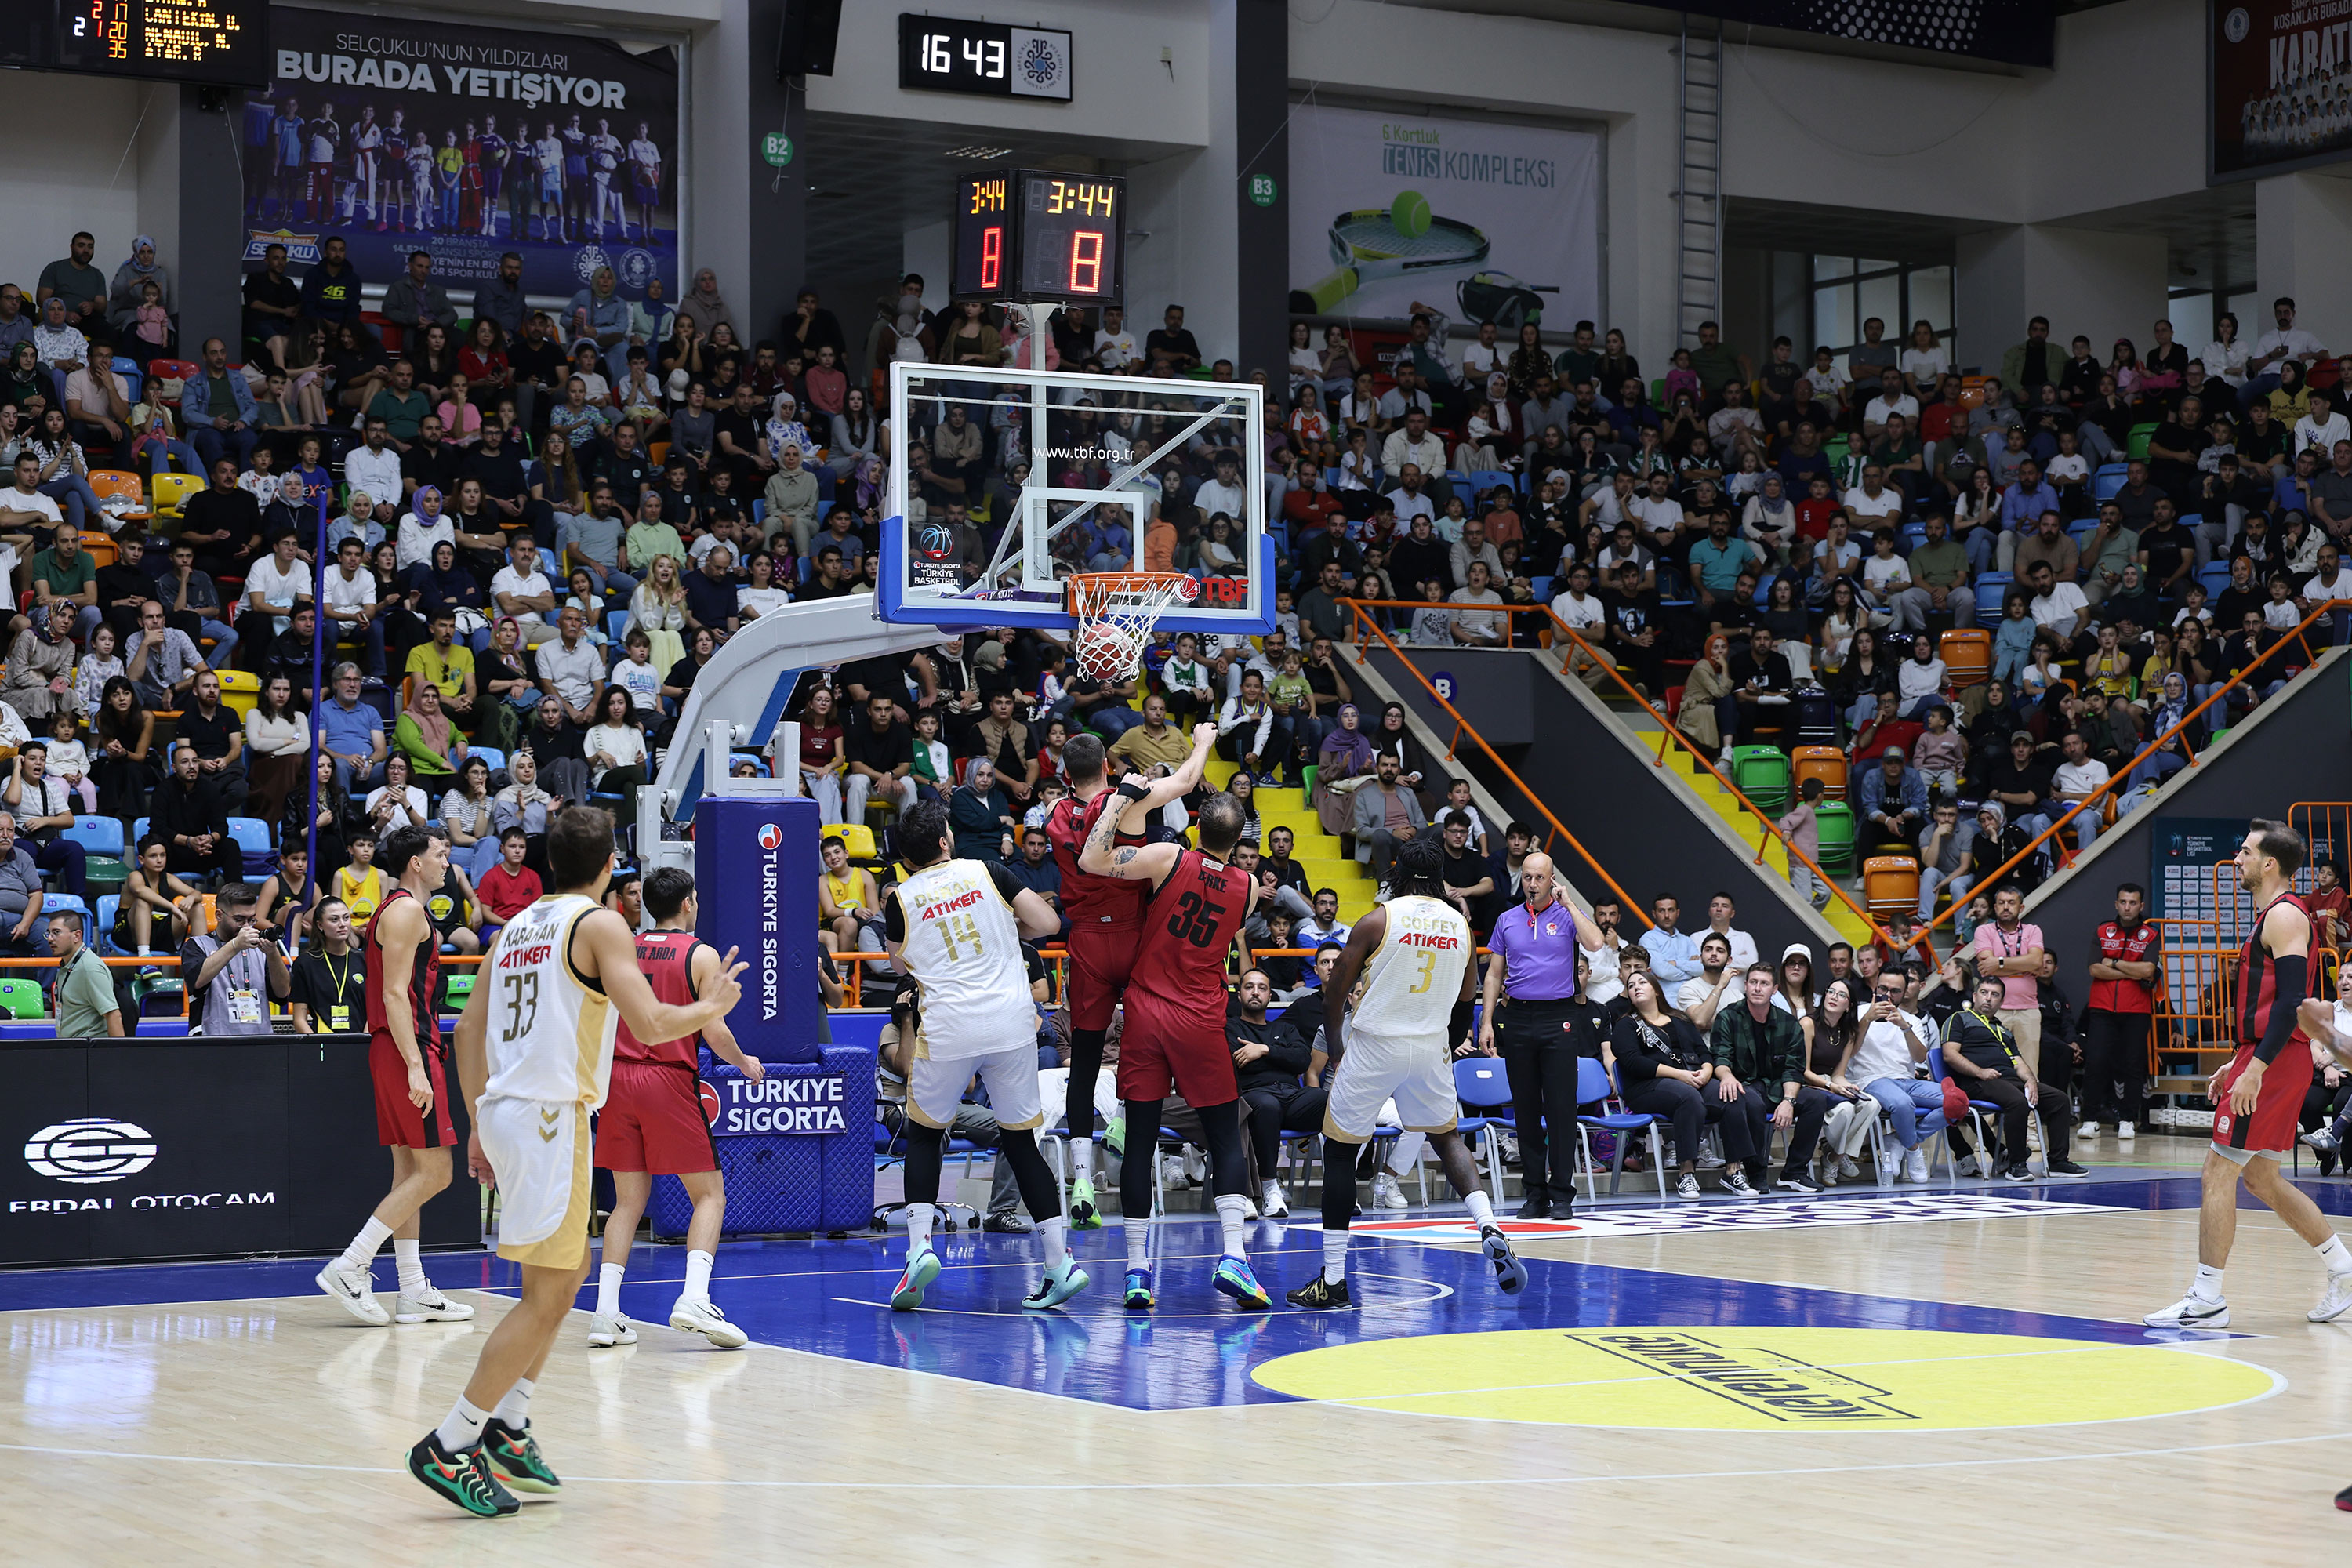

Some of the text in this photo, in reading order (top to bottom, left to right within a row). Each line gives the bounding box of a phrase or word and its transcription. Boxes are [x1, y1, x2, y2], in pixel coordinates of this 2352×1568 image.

[74, 16, 85, 37] 2
[108, 21, 128, 39] 20
[2274, 7, 2318, 31] KOŞANLAR
[108, 40, 127, 59] 35
[336, 33, 568, 71] SELÇUKLU'NUN YILDIZLARI
[921, 34, 1004, 78] 16 43
[277, 49, 437, 93] BURADA
[767, 137, 786, 155] B2
[1382, 124, 1439, 145] 6 Kortluk
[971, 180, 1005, 214] 3:44
[1047, 181, 1114, 218] 3:44
[1254, 179, 1272, 195] B3
[1070, 230, 1103, 293] 8
[324, 285, 346, 296] 46
[1033, 445, 1135, 463] www.tbf.org.tr
[921, 568, 954, 578] TÜRKİYE
[1201, 577, 1249, 602] TBF
[1436, 679, 1450, 699] B
[762, 851, 777, 932] TÜRKİYE
[913, 878, 978, 909] DURAN
[1167, 891, 1227, 949] 35
[1401, 915, 1458, 935] COFFEY
[935, 913, 984, 963] 14
[648, 946, 677, 960] ARDA
[762, 938, 777, 1021] SİGORTA
[1409, 949, 1436, 994] 3
[503, 971, 539, 1043] 33
[727, 1077, 843, 1104] TÜRKİYE
[727, 1105, 846, 1132] SİGORTA
[130, 1192, 275, 1210] OTOCAM
